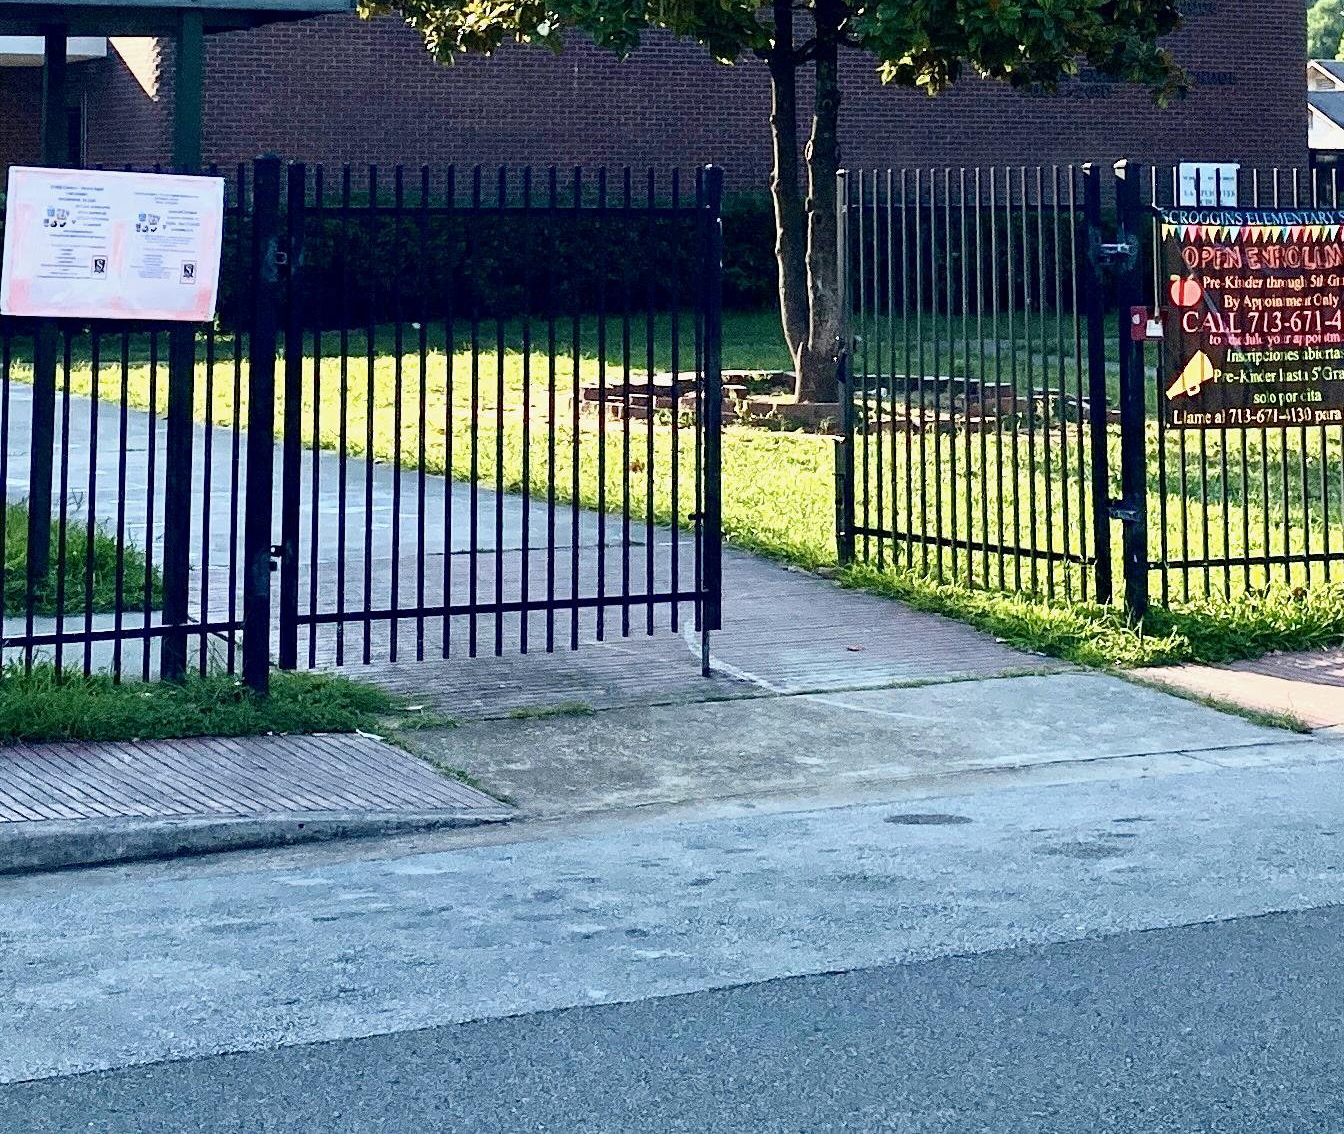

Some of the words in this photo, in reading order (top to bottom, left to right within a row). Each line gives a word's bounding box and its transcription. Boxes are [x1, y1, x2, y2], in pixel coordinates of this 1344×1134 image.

[1161, 209, 1244, 225] SCROGGINS
[1246, 209, 1335, 226] ELEMENTARY
[1182, 245, 1243, 270] OPEN
[1203, 275, 1264, 289] Pre-Kinder
[1224, 294, 1240, 310] By
[1313, 292, 1339, 308] Only
[1182, 311, 1242, 334] CALL
[1209, 333, 1222, 345] to
[1253, 391, 1277, 404] solo
[1278, 392, 1299, 406] por
[1300, 387, 1323, 403] cita
[1173, 409, 1212, 425] Llame
[1228, 406, 1312, 424] 713-671-4130
[1314, 408, 1342, 424] para
